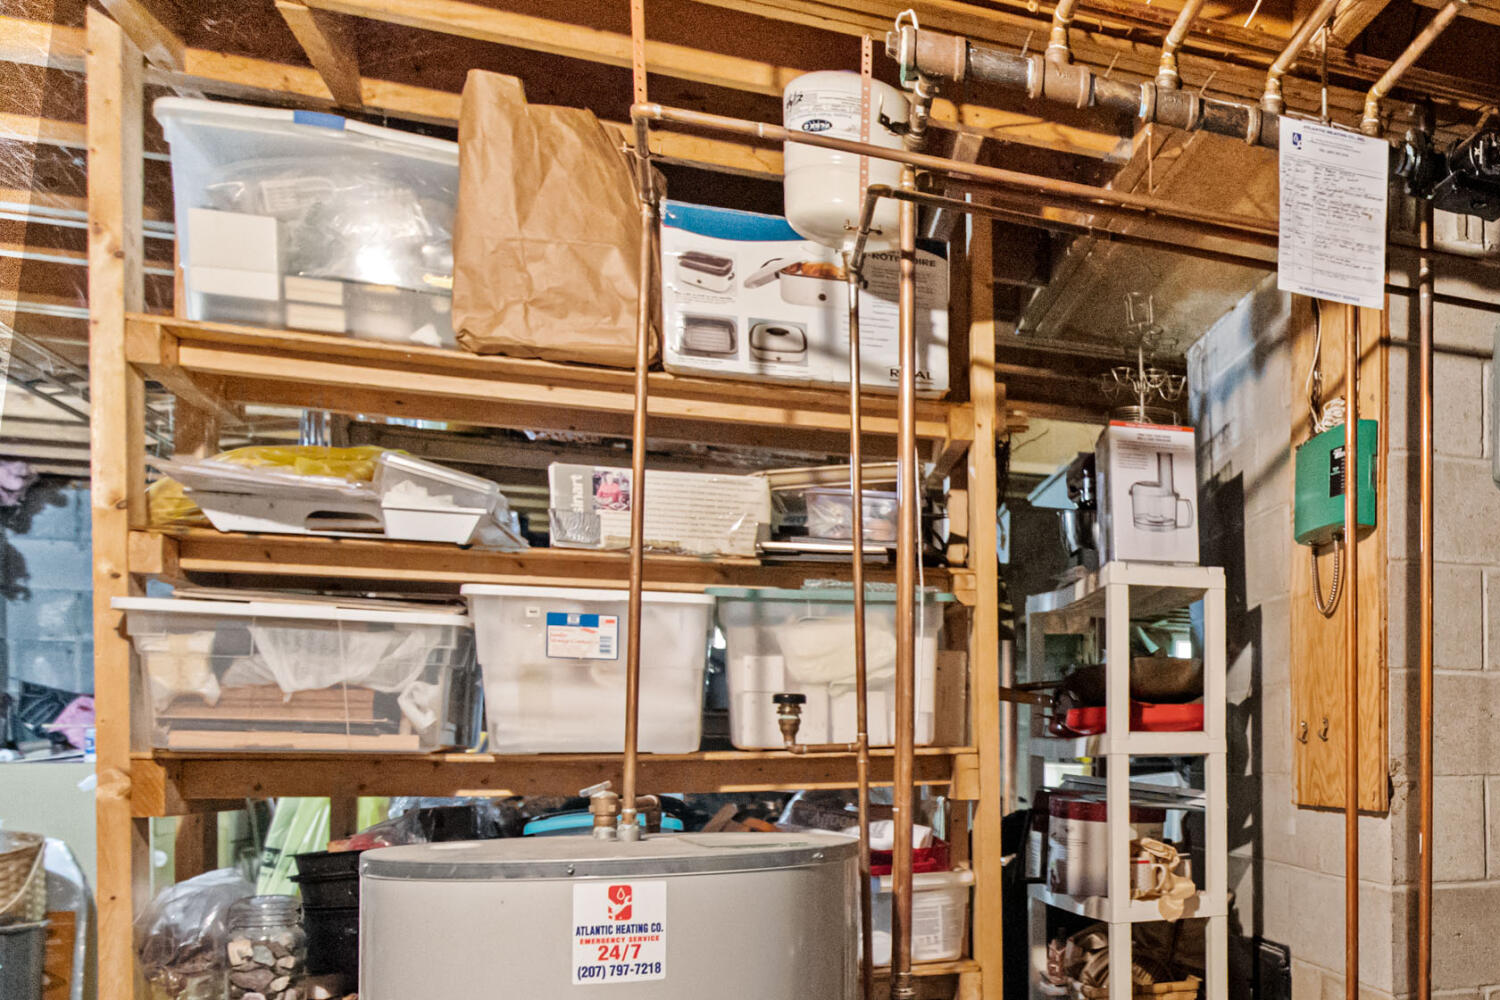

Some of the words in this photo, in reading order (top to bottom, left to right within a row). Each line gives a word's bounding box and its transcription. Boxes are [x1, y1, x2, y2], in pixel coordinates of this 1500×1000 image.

[890, 368, 936, 380] RAL
[575, 925, 613, 936] ATLANTIC
[615, 923, 648, 934] HEATING
[650, 922, 664, 933] CO.
[579, 936, 625, 945] EMERGENCY
[628, 935, 660, 943] SERVICE
[597, 944, 642, 962] 24/7
[577, 965, 606, 980] (207)
[609, 961, 662, 977] 797-7218
